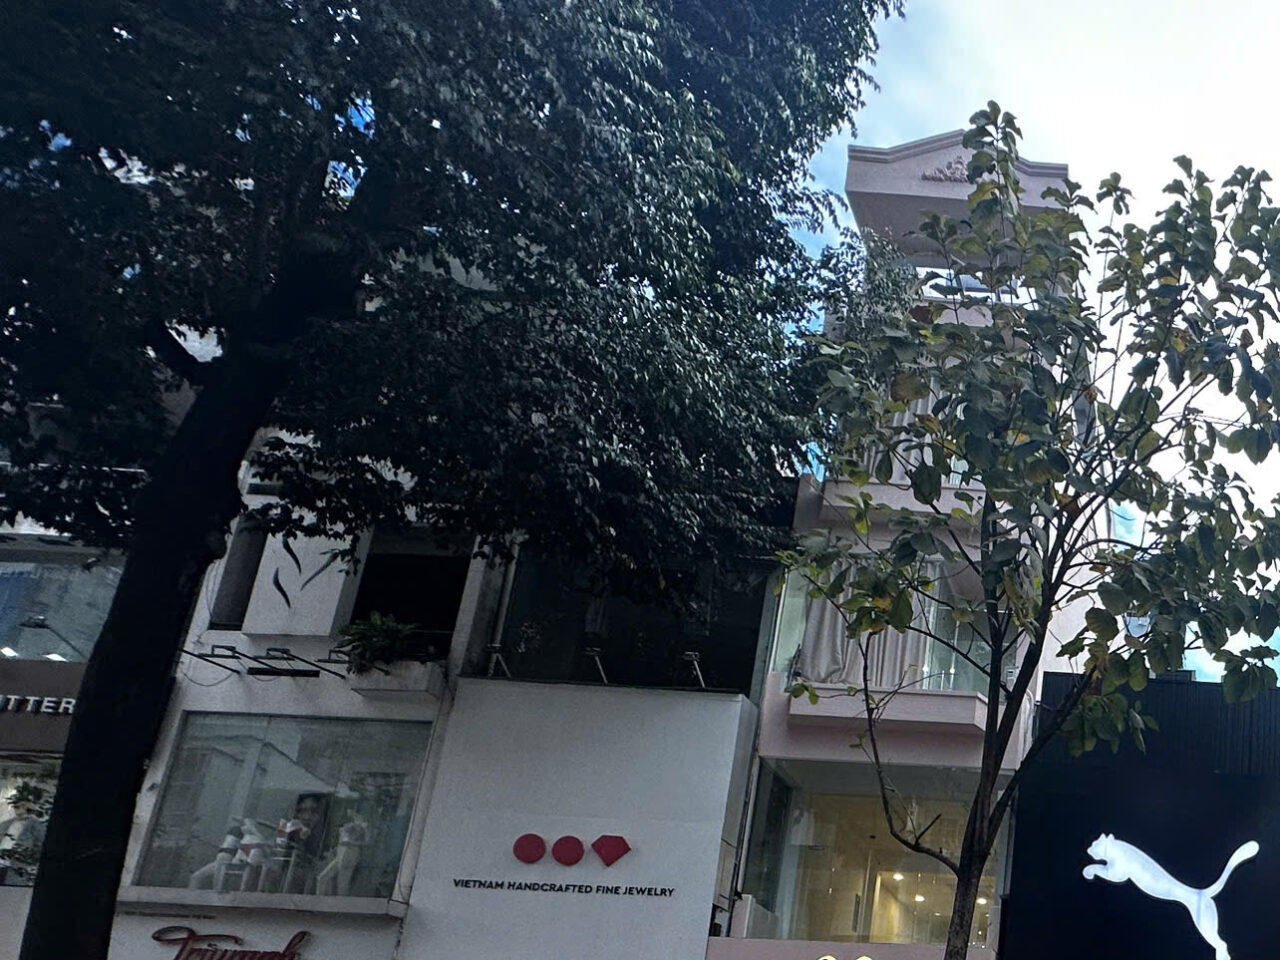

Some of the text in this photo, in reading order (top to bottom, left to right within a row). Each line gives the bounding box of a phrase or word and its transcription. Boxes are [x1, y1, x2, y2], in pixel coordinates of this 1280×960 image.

[453, 879, 675, 897] VIETNAM HANDCRAFTED FINE JEWELRY
